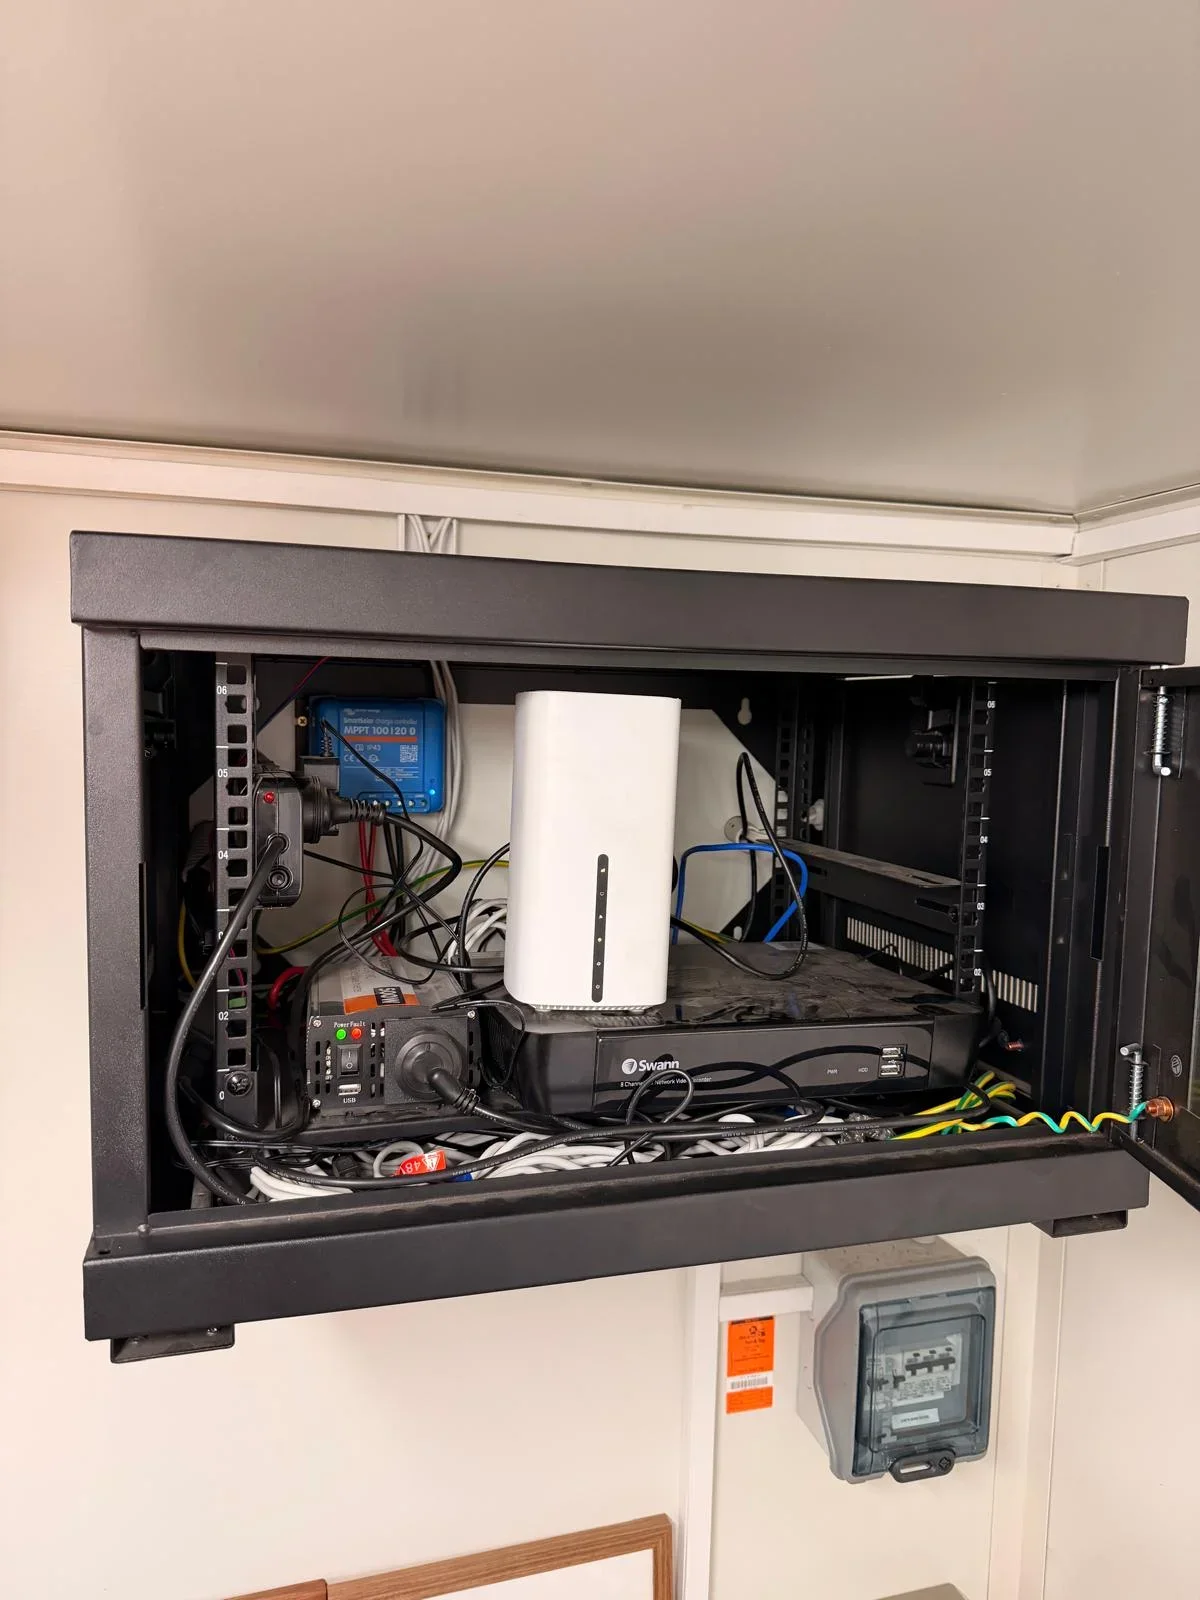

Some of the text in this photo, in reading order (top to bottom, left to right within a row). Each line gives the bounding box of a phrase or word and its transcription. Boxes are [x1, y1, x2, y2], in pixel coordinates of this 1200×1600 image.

[217, 685, 227, 695] 06
[344, 726, 370, 735] MPPT
[217, 768, 228, 778] 05
[984, 768, 992, 777] 05
[218, 851, 229, 860] 04
[974, 968, 982, 976] 02
[218, 1011, 229, 1021] 02
[639, 1060, 679, 1071] Swann
